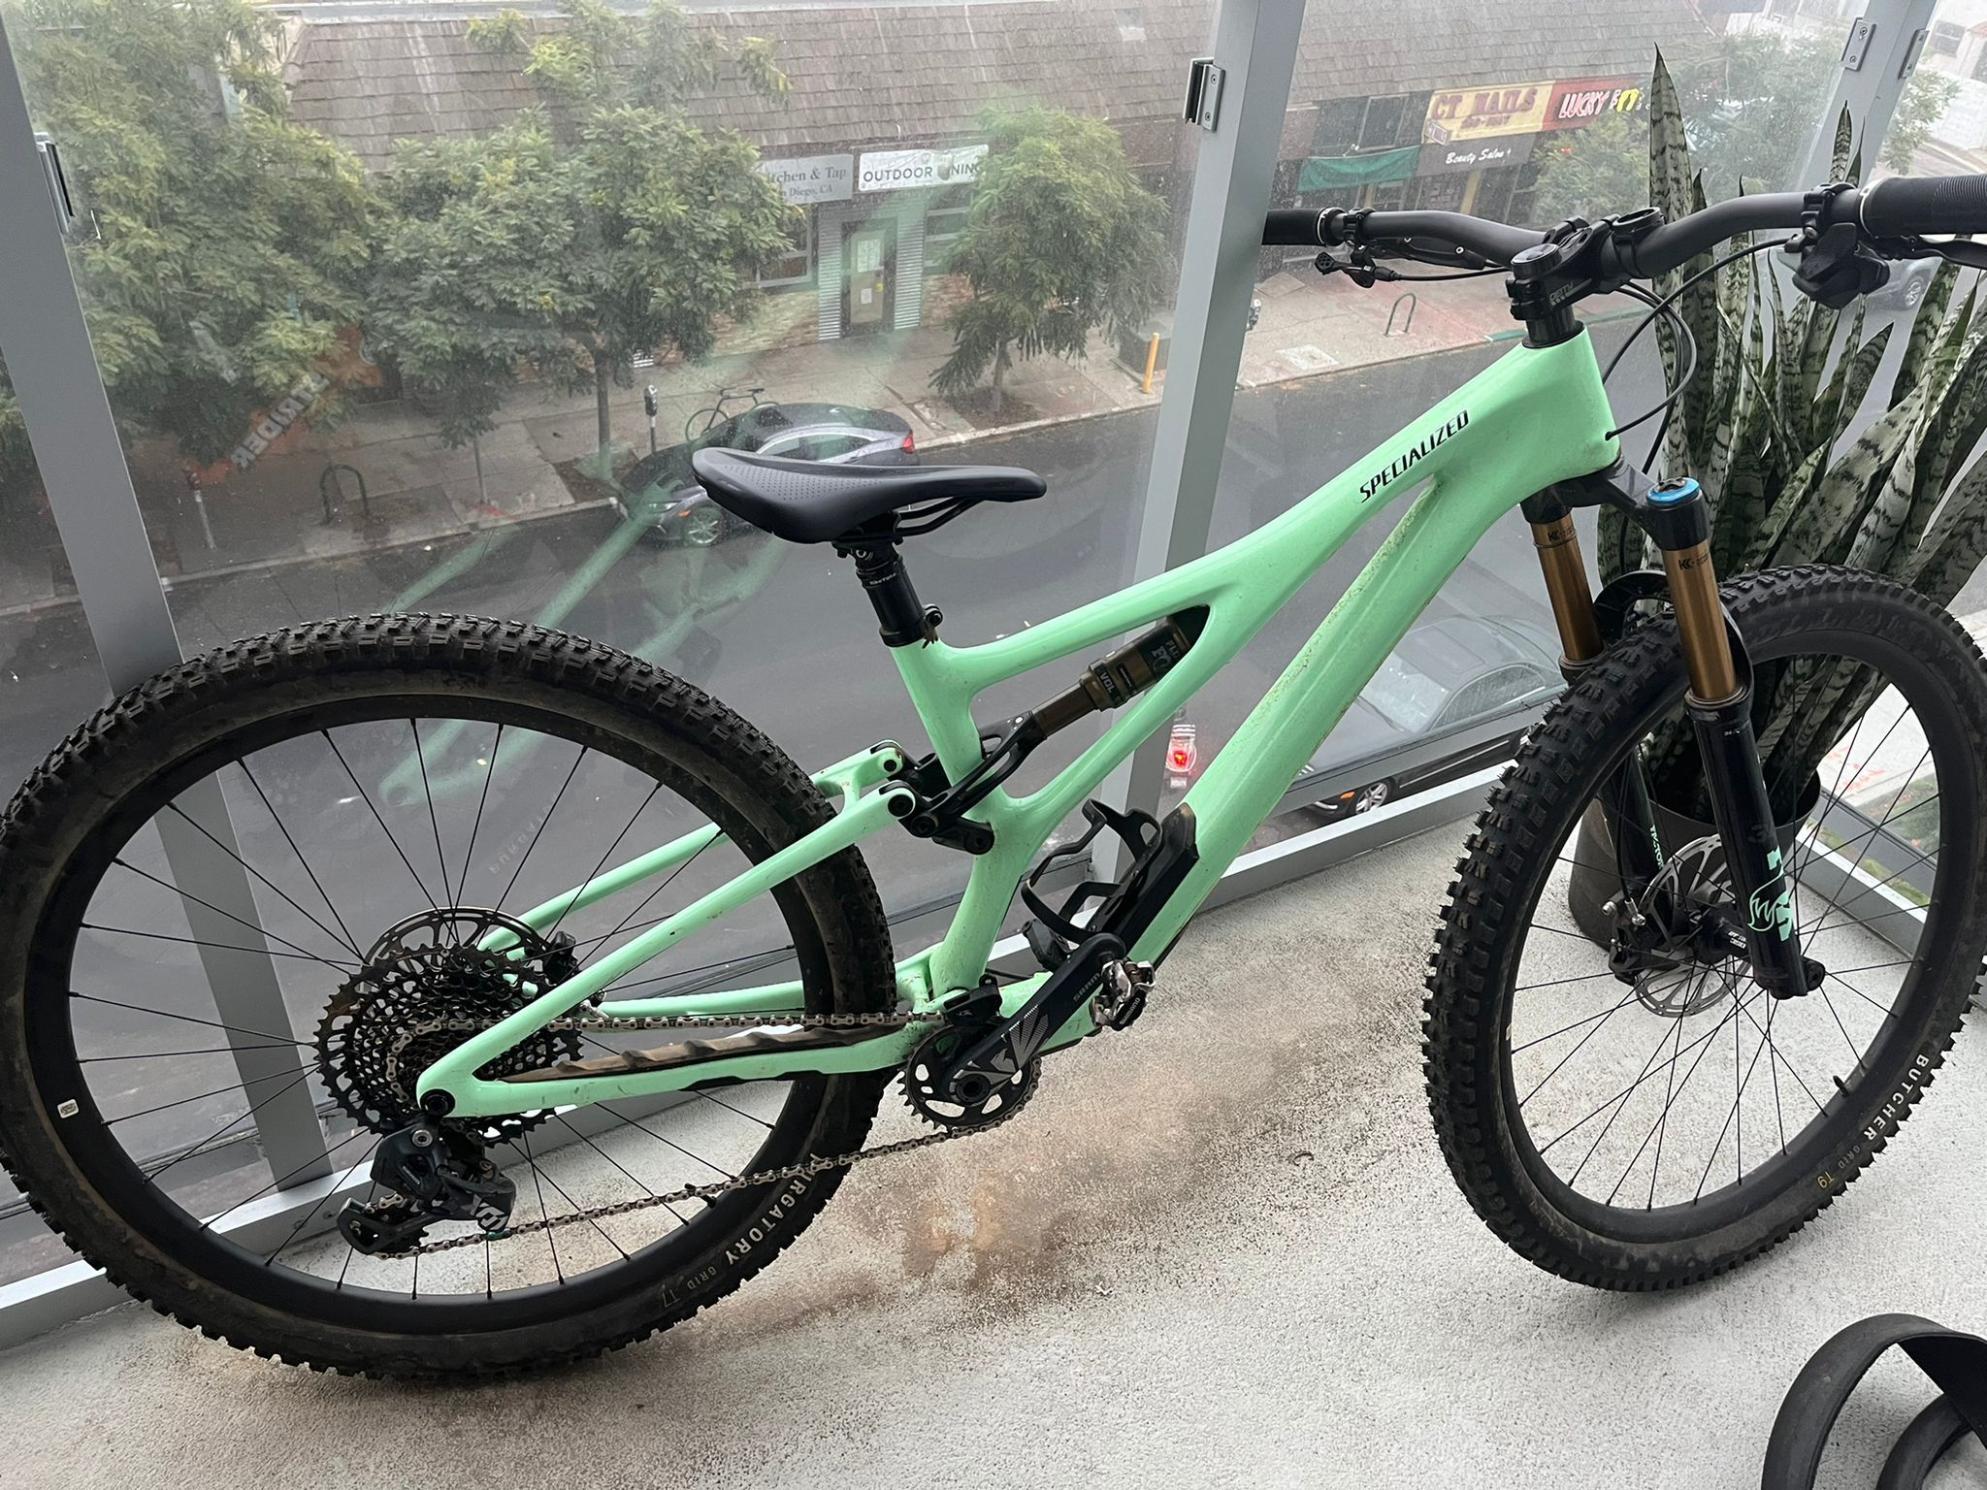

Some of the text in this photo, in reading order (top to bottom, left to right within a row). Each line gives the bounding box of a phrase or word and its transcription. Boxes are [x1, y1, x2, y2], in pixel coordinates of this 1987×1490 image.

[1431, 87, 1539, 120] CT NAILS
[1558, 91, 1611, 119] LUCKY
[1445, 148, 1504, 165] Beauty Salon
[766, 166, 848, 184] itchen & Tap
[862, 166, 934, 183] OUTDOOR
[820, 184, 834, 195] CA
[1359, 409, 1470, 504] SPECIALIZED
[1100, 672, 1116, 694] VOL
[1863, 1054, 1930, 1142] BUTCHER
[686, 1265, 718, 1291] GRID
